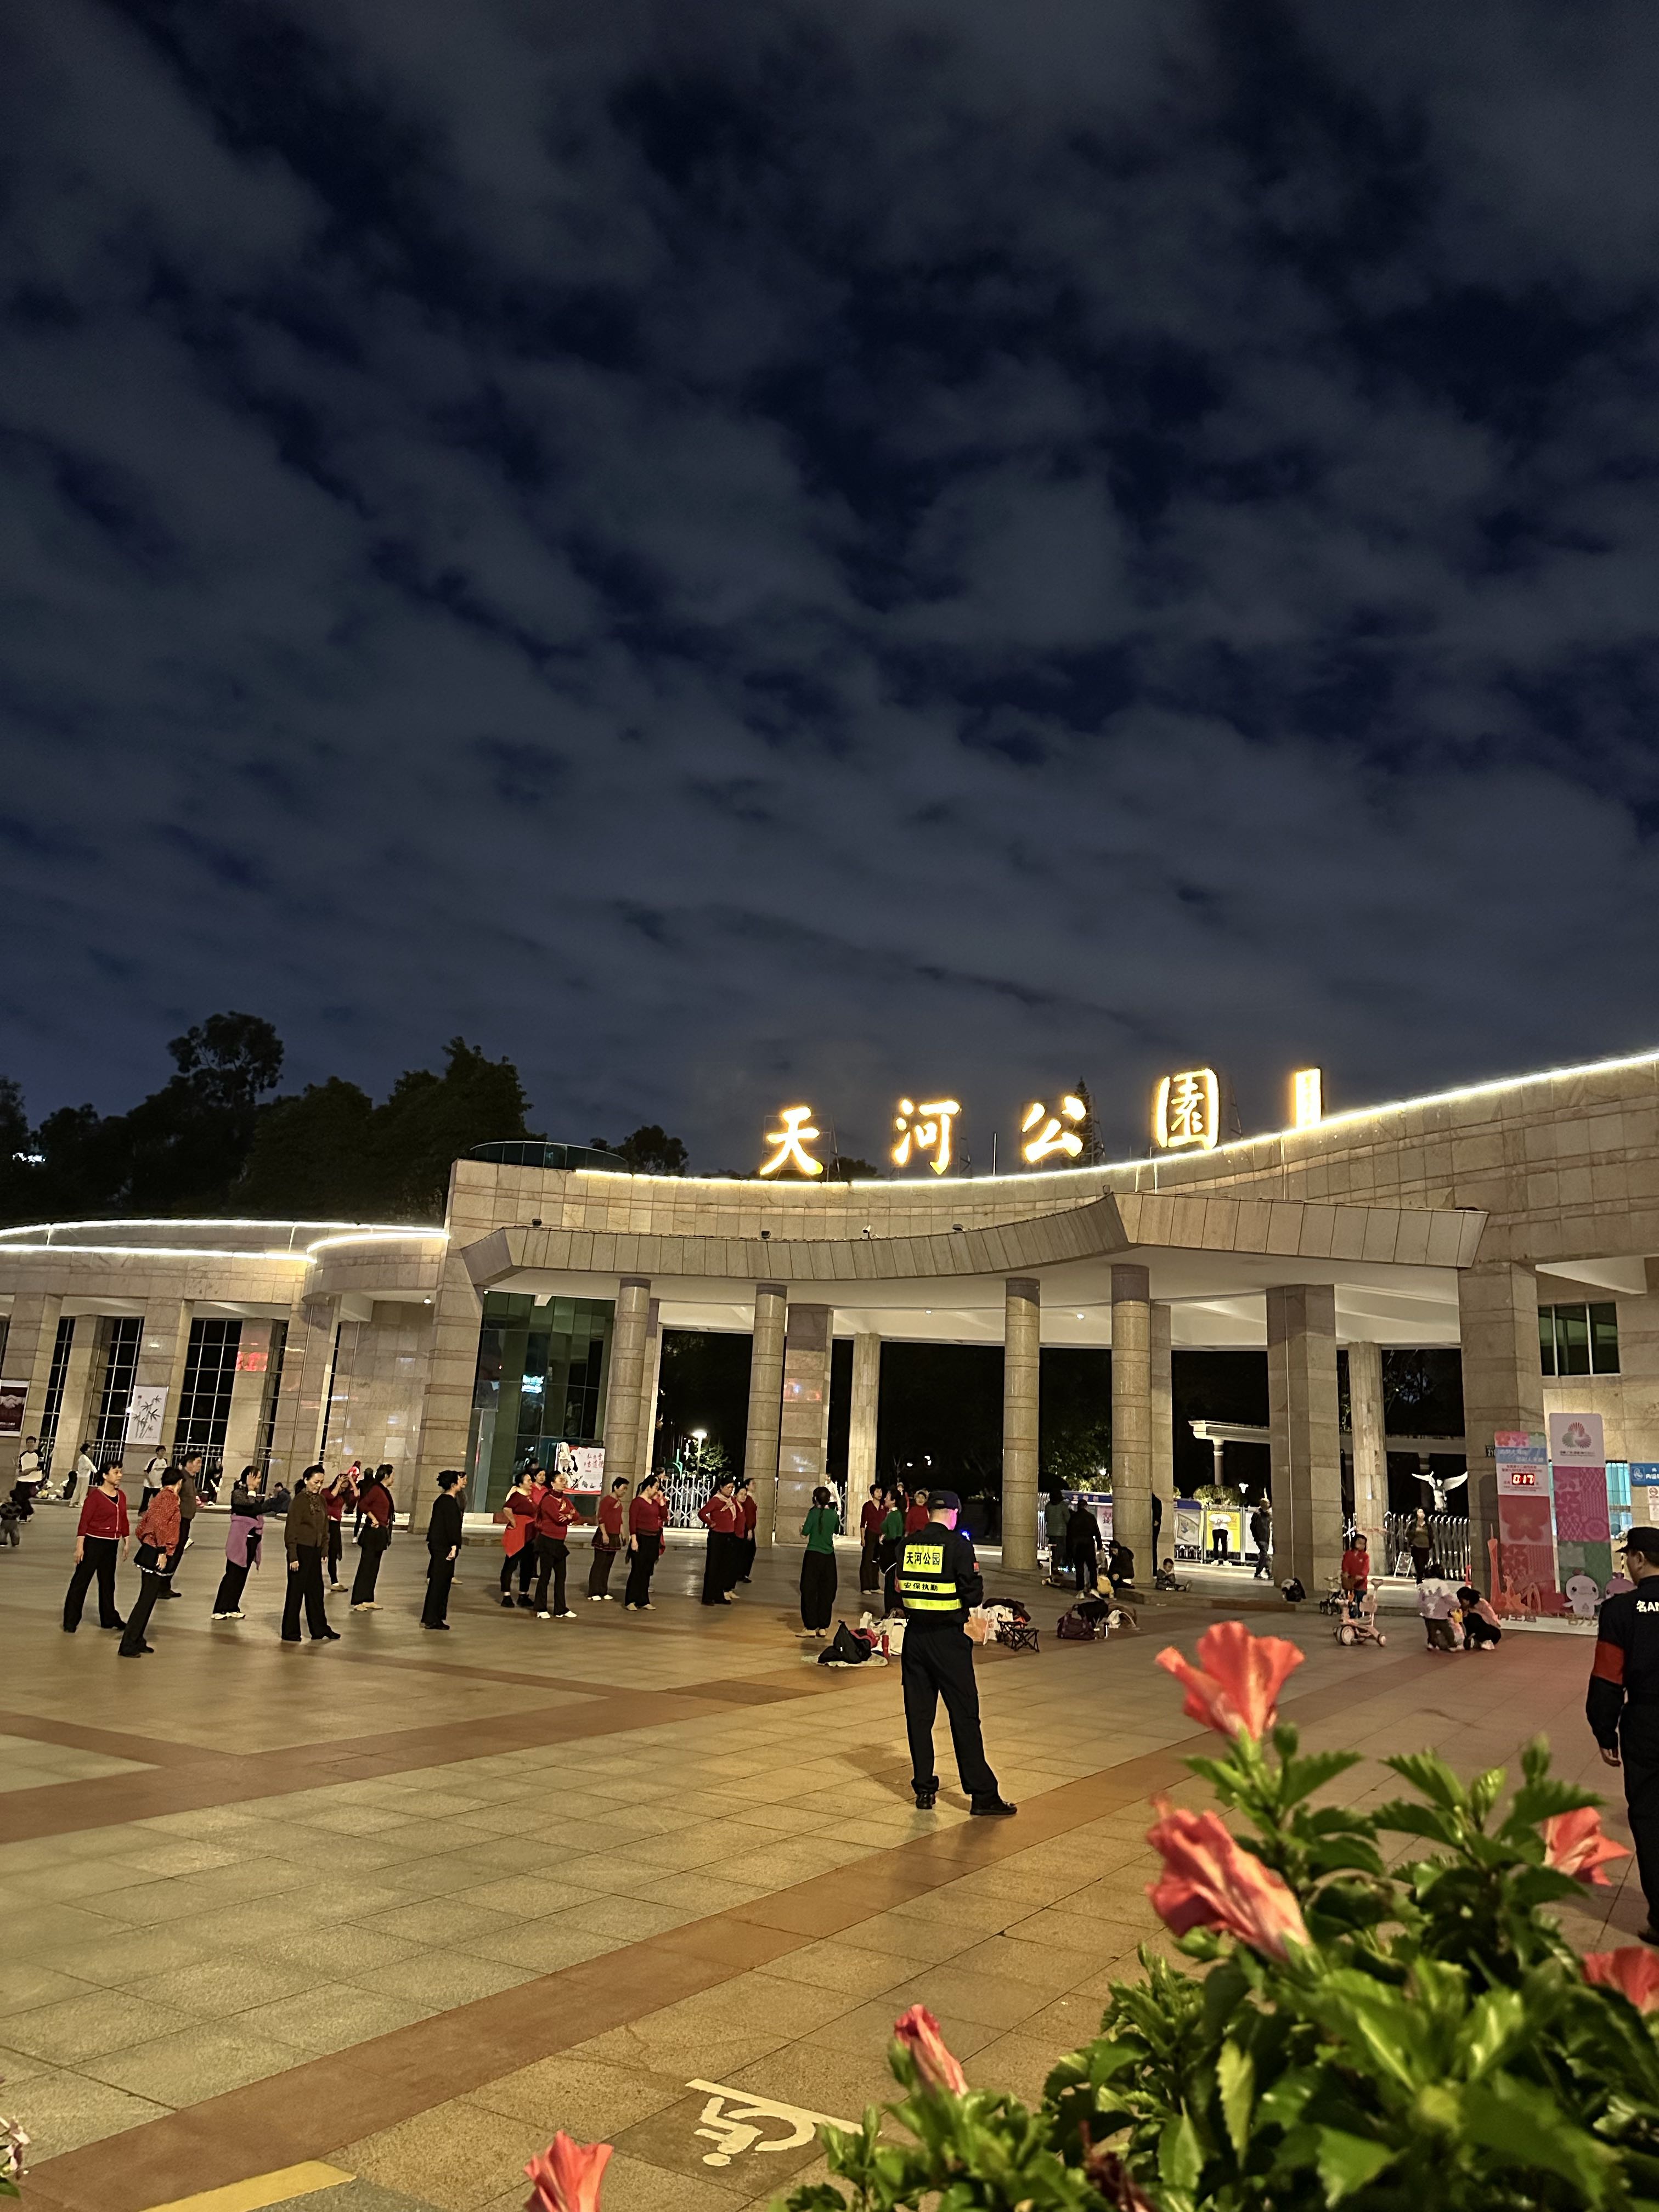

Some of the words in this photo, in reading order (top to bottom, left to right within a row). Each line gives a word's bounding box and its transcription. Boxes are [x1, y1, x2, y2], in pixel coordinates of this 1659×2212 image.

[1513, 1474, 1535, 1484] 017
[906, 1552, 940, 1565] 天河公园
[904, 1582, 938, 1591] 安保执勤
